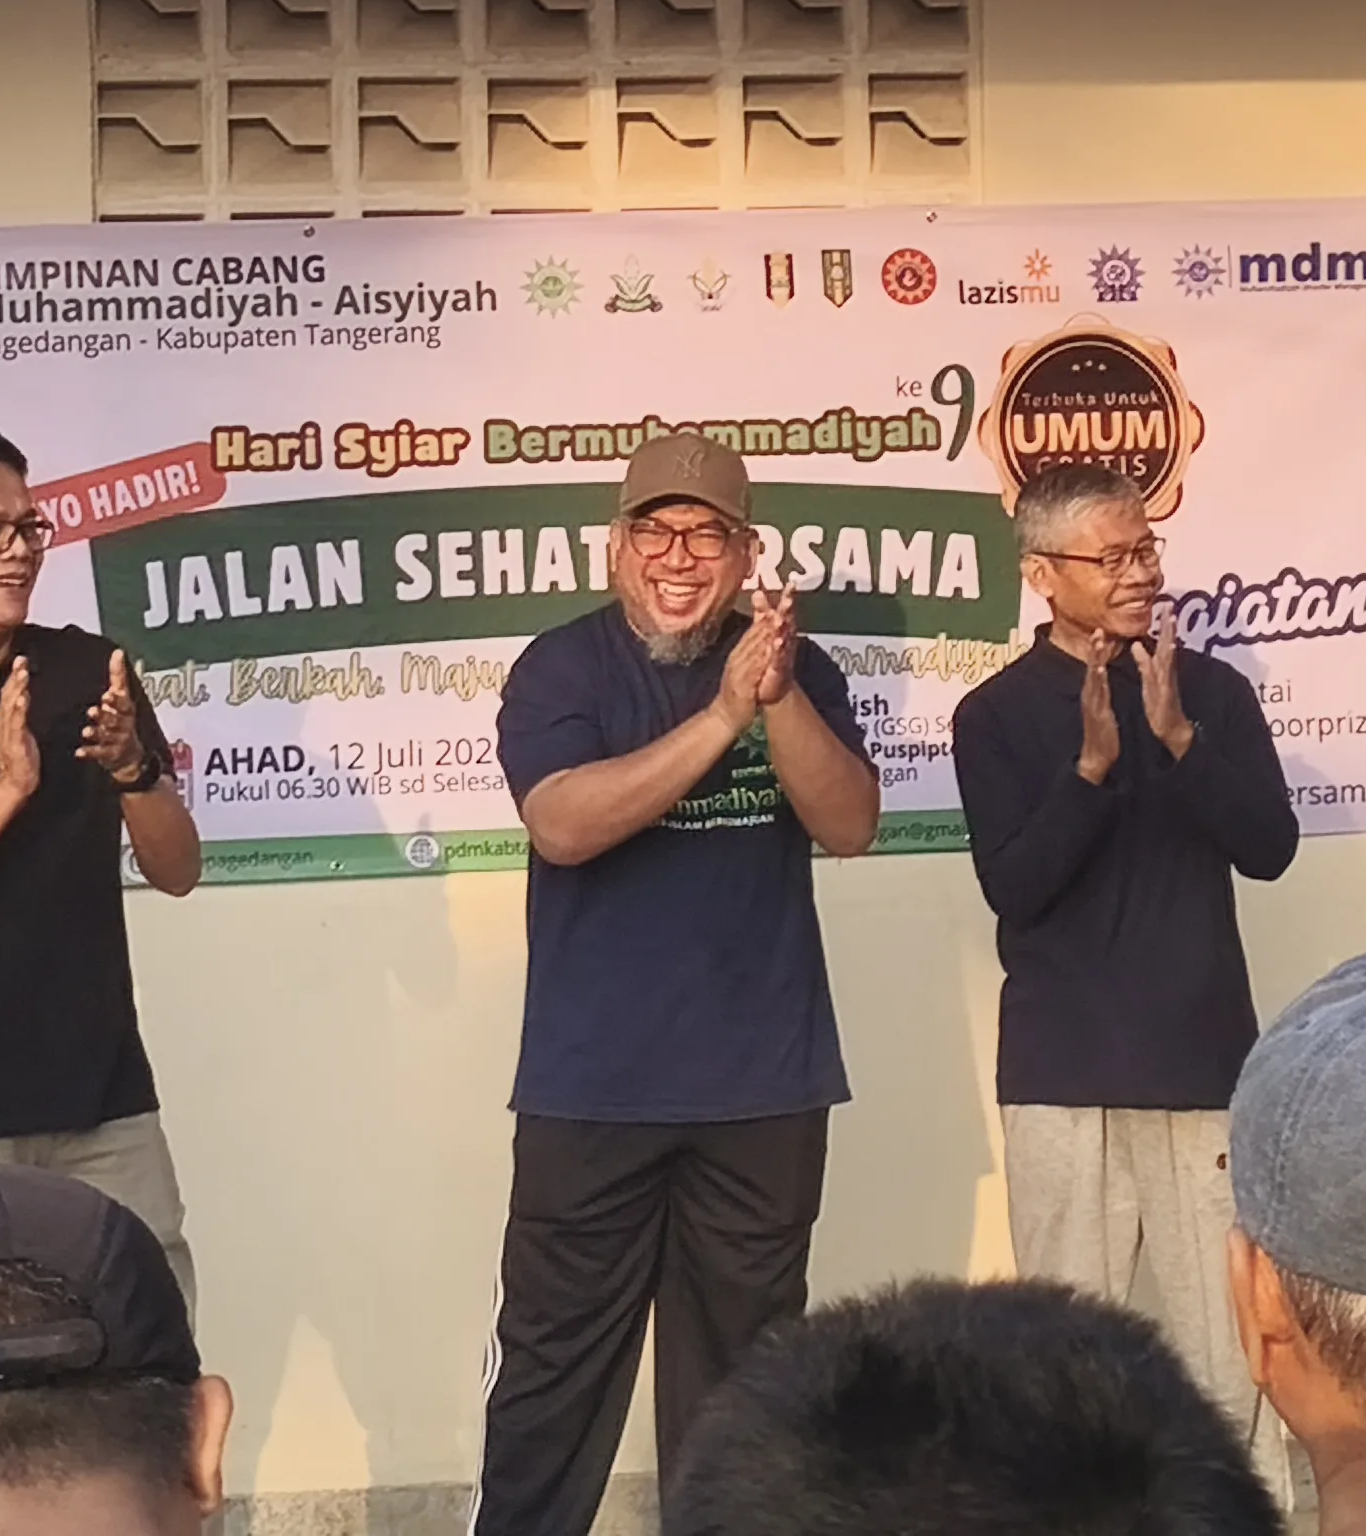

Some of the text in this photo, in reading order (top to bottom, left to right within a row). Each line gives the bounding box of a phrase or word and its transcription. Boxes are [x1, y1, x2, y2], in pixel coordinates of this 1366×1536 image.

[173, 255, 326, 285] CABANG
[335, 281, 497, 325] Aisyiyah
[959, 278, 1061, 305] lazismu
[157, 326, 297, 354] Kabupaten
[305, 323, 441, 348] Tangerang
[896, 364, 975, 462] ke 9
[1021, 390, 1159, 407] Terbuka Untuk
[212, 407, 941, 476] Hari Syiar Bermummadiyah
[1013, 410, 1167, 454] UMUM
[34, 460, 201, 533] YO HADIR!
[143, 524, 980, 628] JALAN SEHAT RSAMA
[852, 693, 889, 717] ish
[1258, 679, 1292, 704] tai
[874, 717, 929, 739] (GSG)
[204, 737, 493, 777] AHAD, 12 Juli 202
[871, 740, 951, 762] Puspipt
[206, 771, 507, 802] Pukul 06.30 WIB sd Selesa
[881, 765, 919, 787] gan
